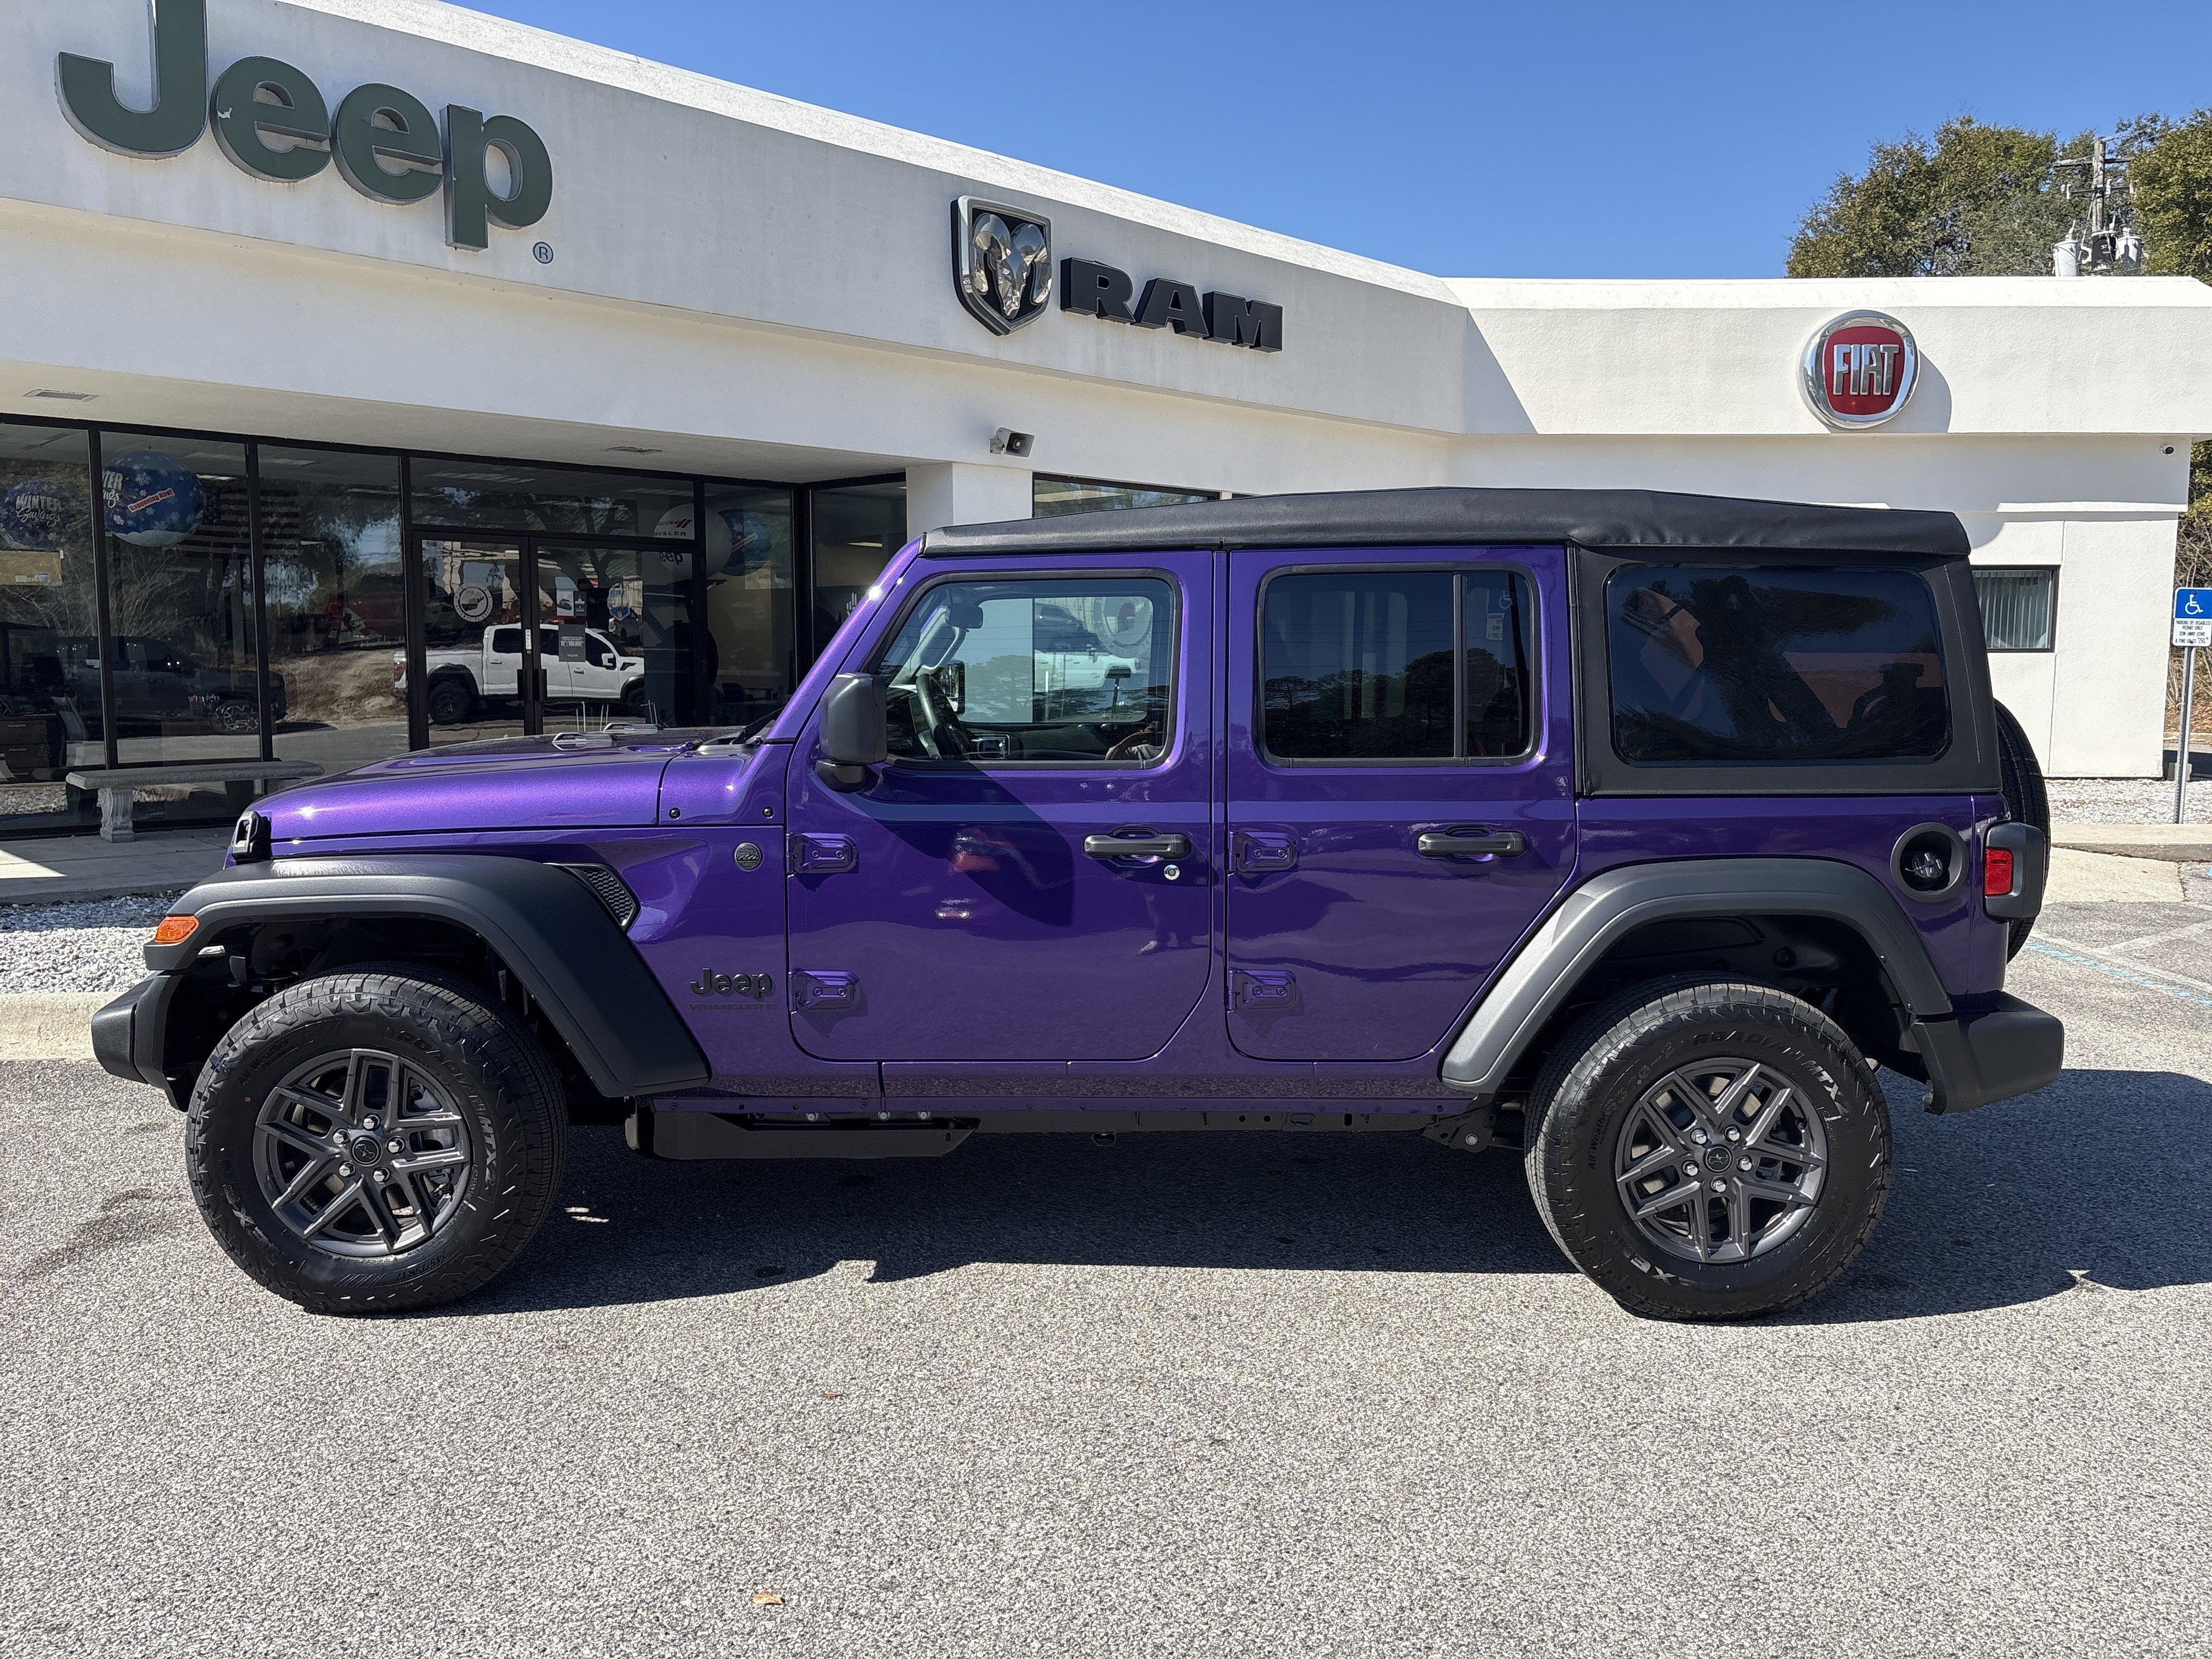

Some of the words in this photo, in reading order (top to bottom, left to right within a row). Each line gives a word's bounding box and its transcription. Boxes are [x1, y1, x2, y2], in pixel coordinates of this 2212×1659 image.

[54, 0, 552, 250] Jeep
[1060, 257, 1283, 353] RAM
[1833, 343, 1899, 396] FIAT
[15, 492, 63, 512] WINTER
[15, 507, 61, 527] Savings
[659, 552, 684, 566] eep
[690, 967, 772, 999] Jeep
